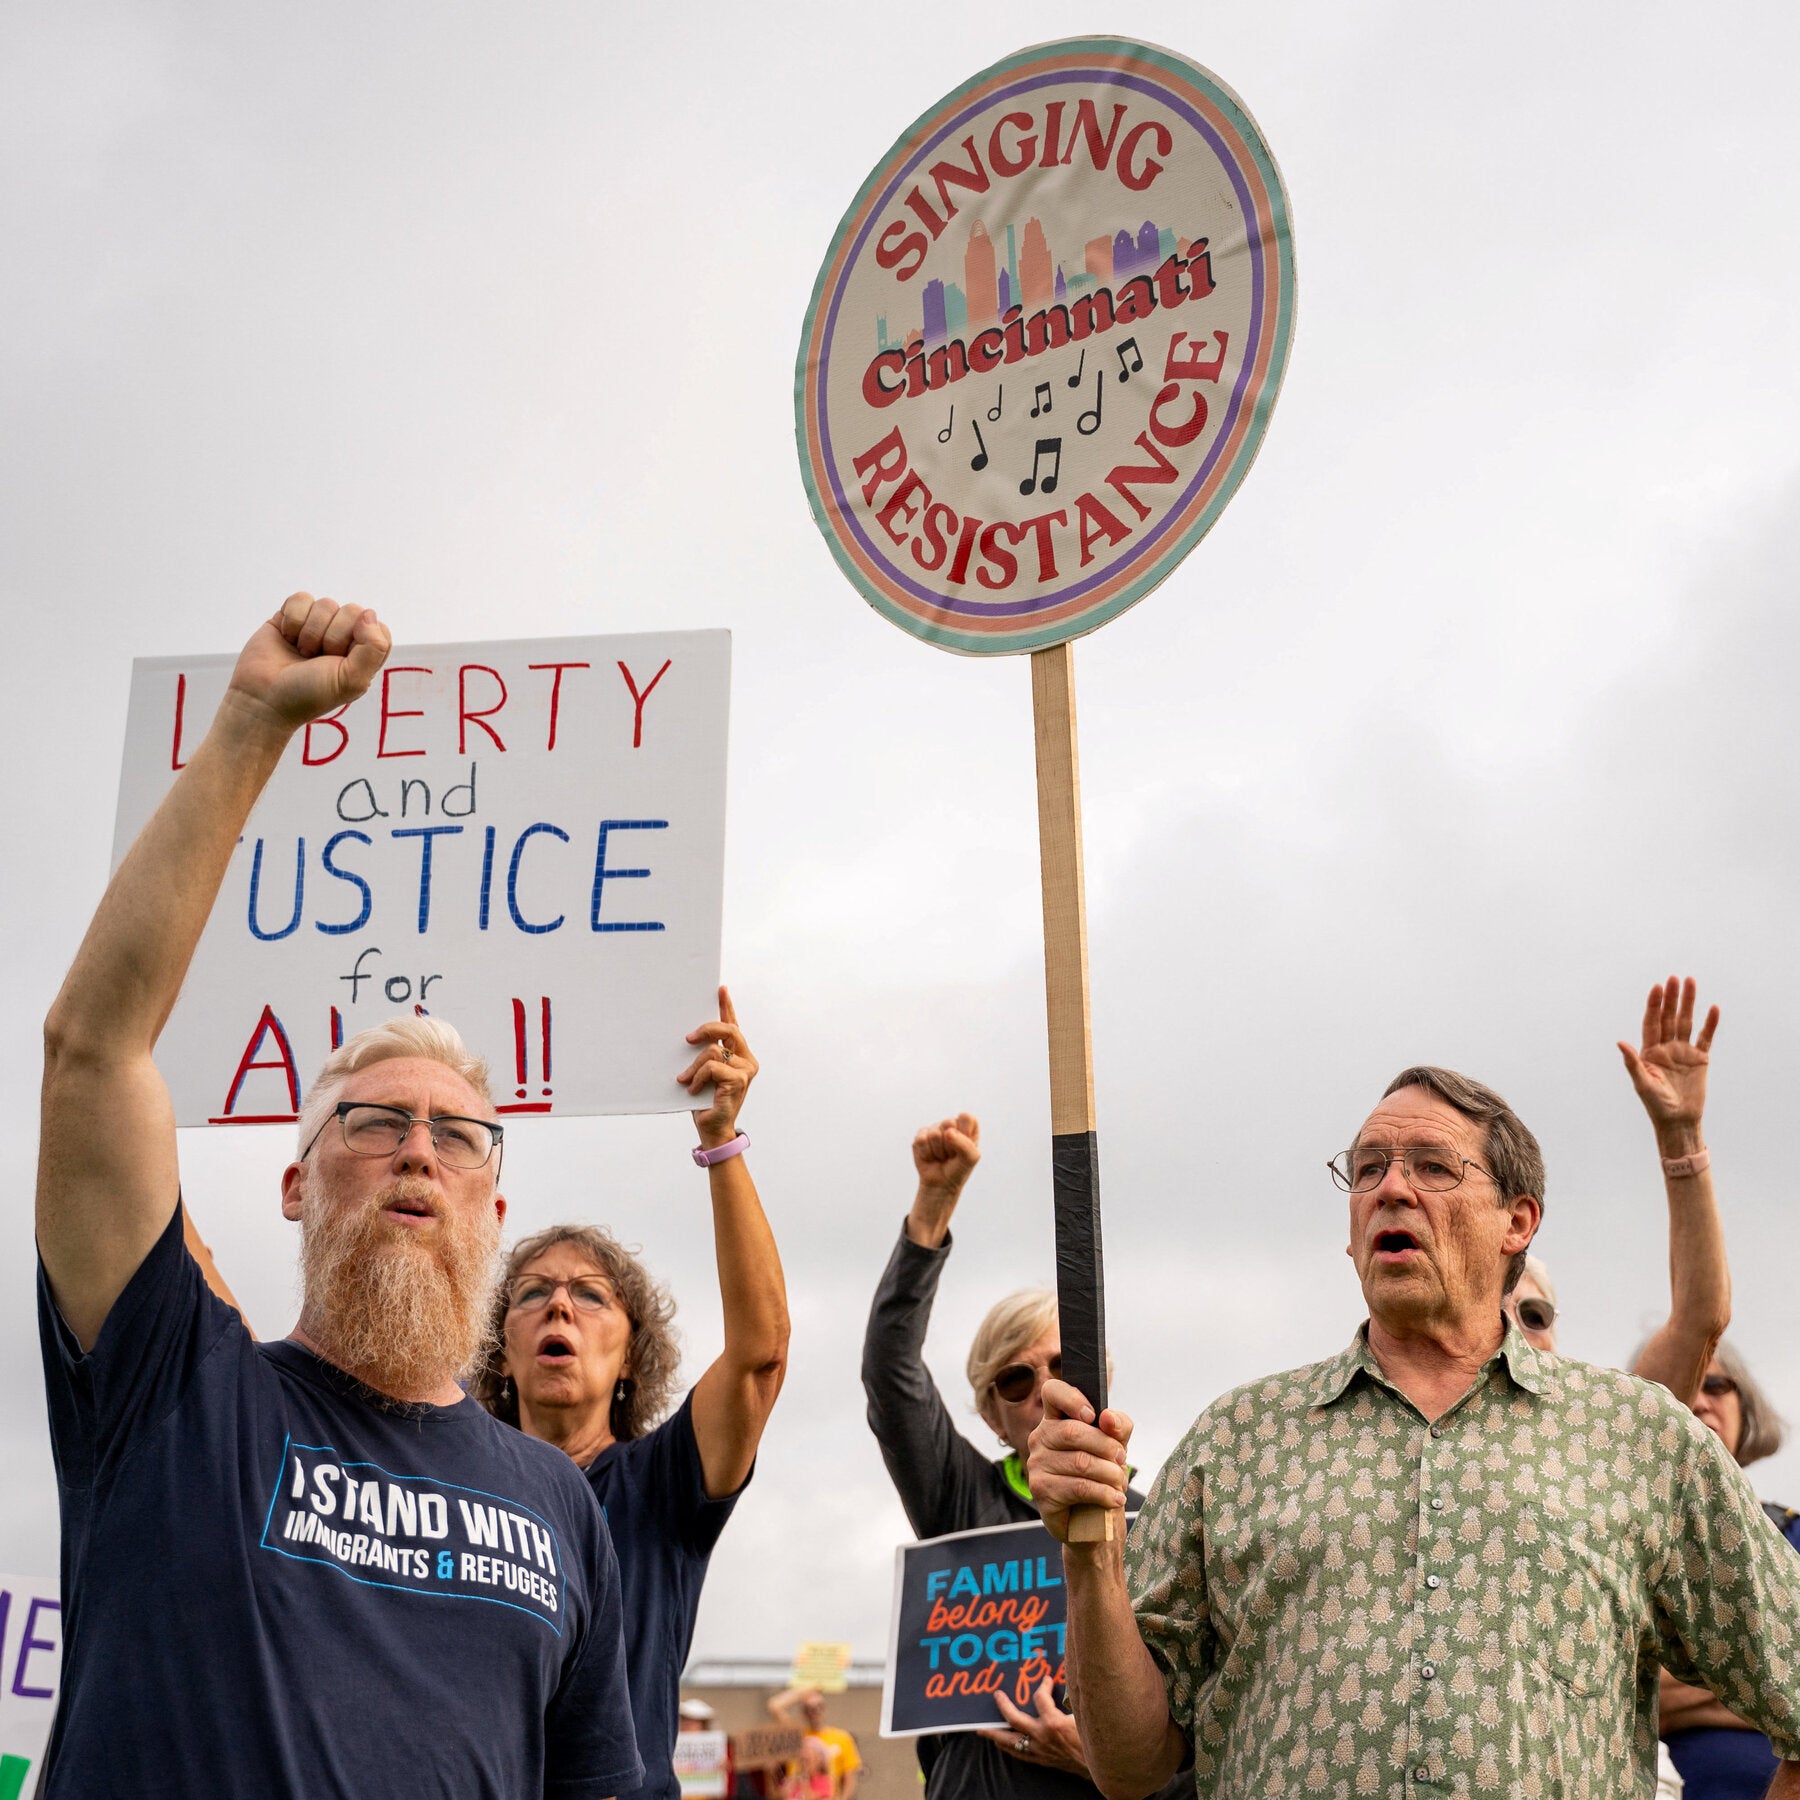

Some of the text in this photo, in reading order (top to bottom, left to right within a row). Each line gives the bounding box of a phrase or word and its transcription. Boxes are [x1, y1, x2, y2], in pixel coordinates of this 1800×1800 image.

[875, 99, 1173, 282] SINGING
[862, 237, 1217, 409] Cincinnati
[852, 329, 1229, 590] RESISTANCE
[172, 659, 672, 771] LBERTY
[337, 762, 477, 822] and
[236, 819, 669, 942] USTICE
[340, 947, 443, 1004] for
[223, 996, 553, 1115] A!!
[283, 1510, 558, 1613] IMMIGRANTS & REFUGEES
[291, 1455, 557, 1577] I STAND WITH
[926, 1556, 1066, 1602] FAMIL
[926, 1593, 1049, 1632] belong
[919, 1622, 1067, 1670] TOGET
[925, 1660, 1004, 1699] and
